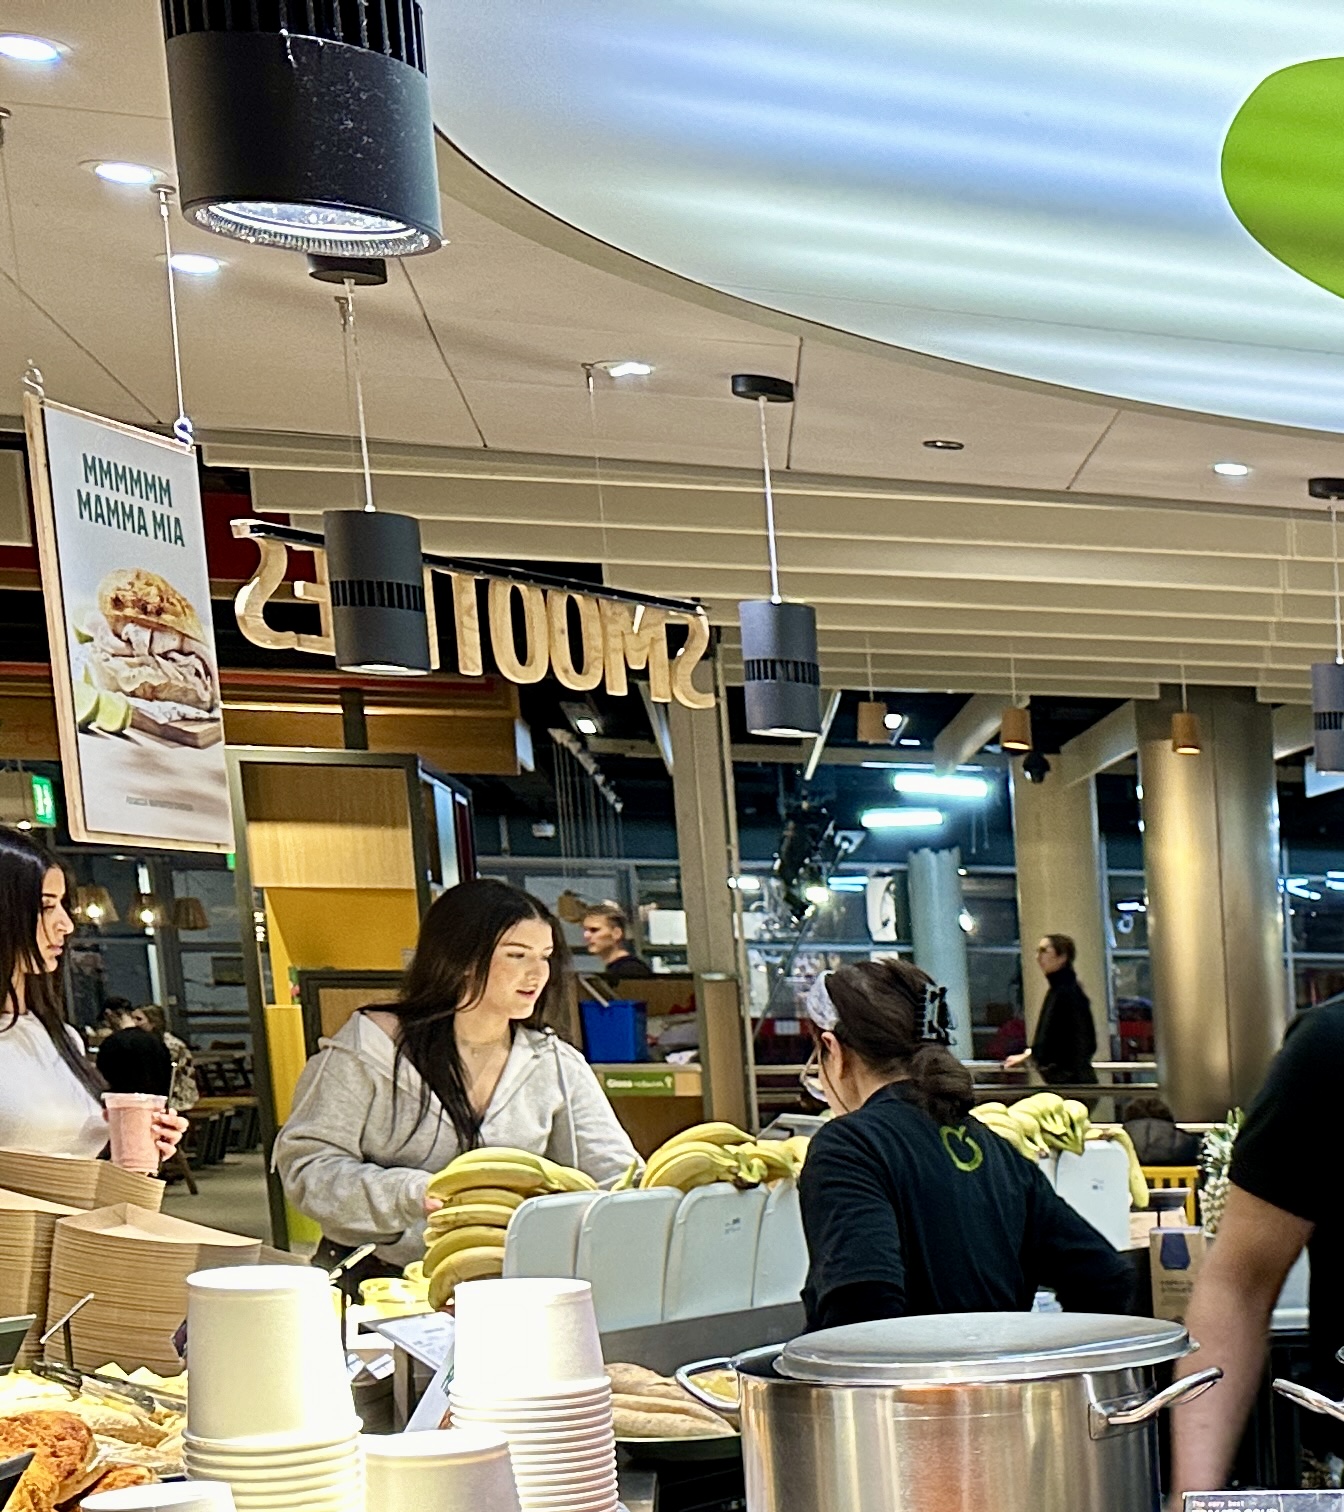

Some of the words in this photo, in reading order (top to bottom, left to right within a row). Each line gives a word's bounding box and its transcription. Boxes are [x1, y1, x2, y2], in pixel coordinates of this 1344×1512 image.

[82, 453, 172, 508] MMMMMM
[76, 489, 149, 538] MAMMA
[152, 510, 185, 547] MIA
